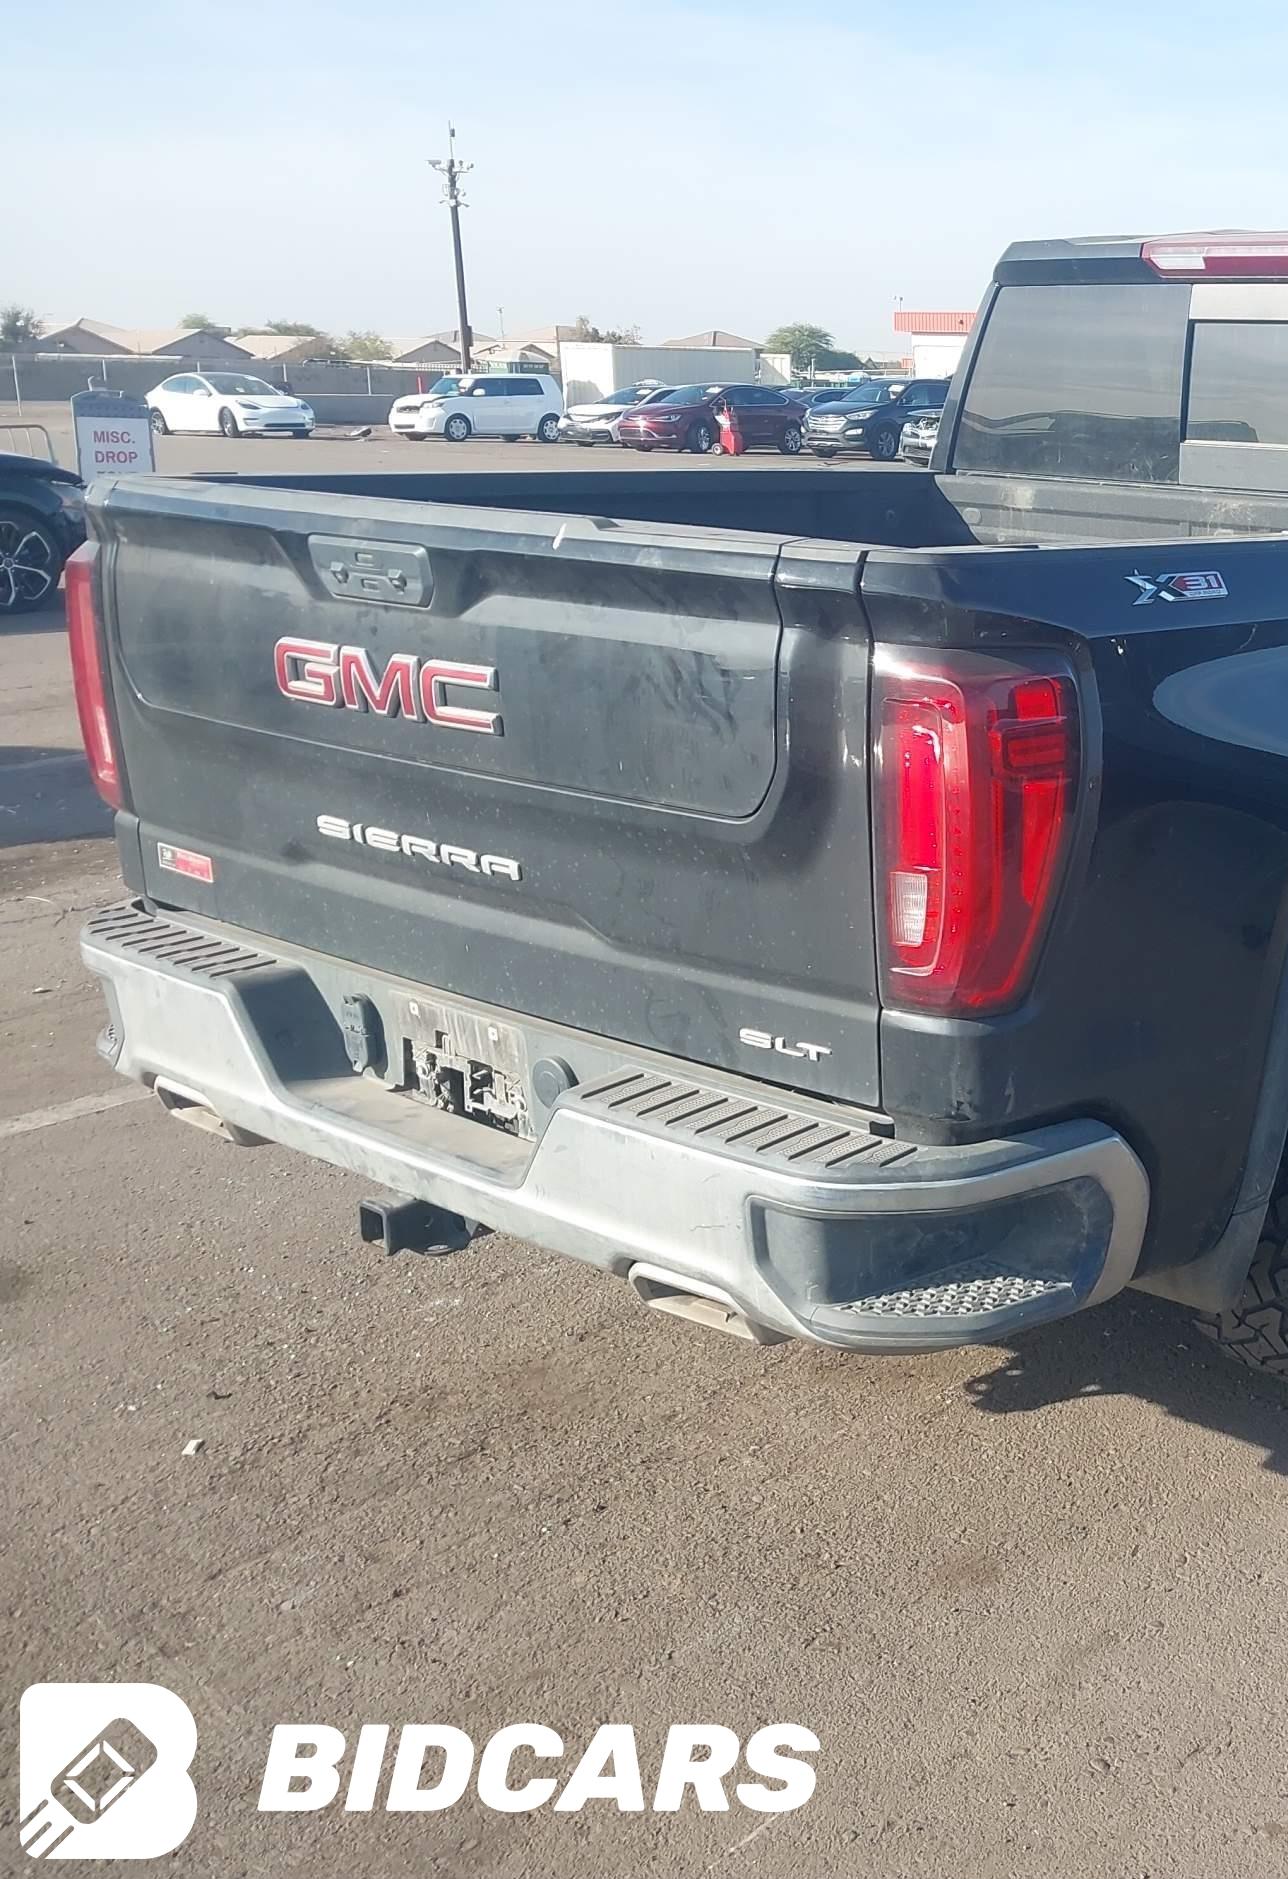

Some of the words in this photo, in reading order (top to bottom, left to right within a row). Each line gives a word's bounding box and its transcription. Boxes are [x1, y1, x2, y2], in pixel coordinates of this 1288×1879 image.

[93, 430, 136, 444] MISC.
[94, 450, 138, 464] DROP
[274, 636, 504, 737] GMC
[316, 814, 523, 881] SIERRA
[739, 1028, 833, 1062] SLT
